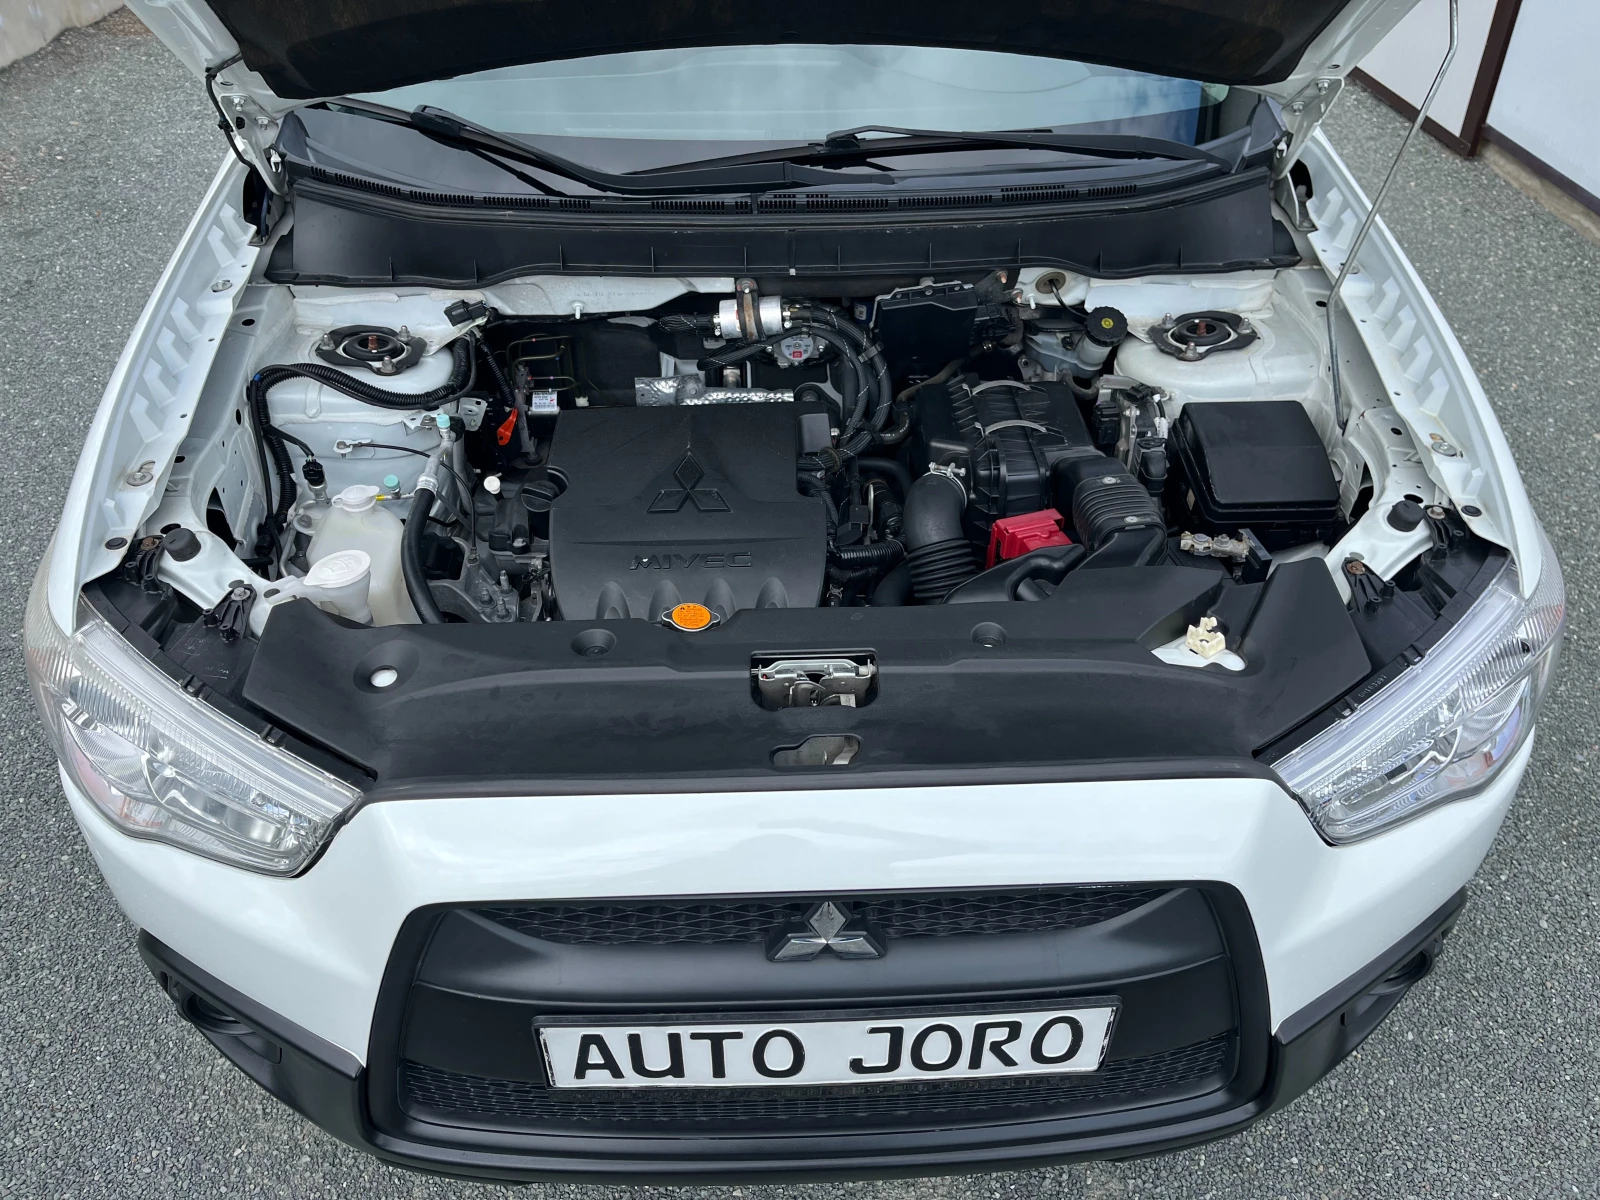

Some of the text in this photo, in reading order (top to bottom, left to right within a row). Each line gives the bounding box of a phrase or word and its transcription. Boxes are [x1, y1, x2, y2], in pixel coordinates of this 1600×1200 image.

[630, 552, 752, 571] MIVEC
[573, 1015, 1084, 1080] AUTO JORO
